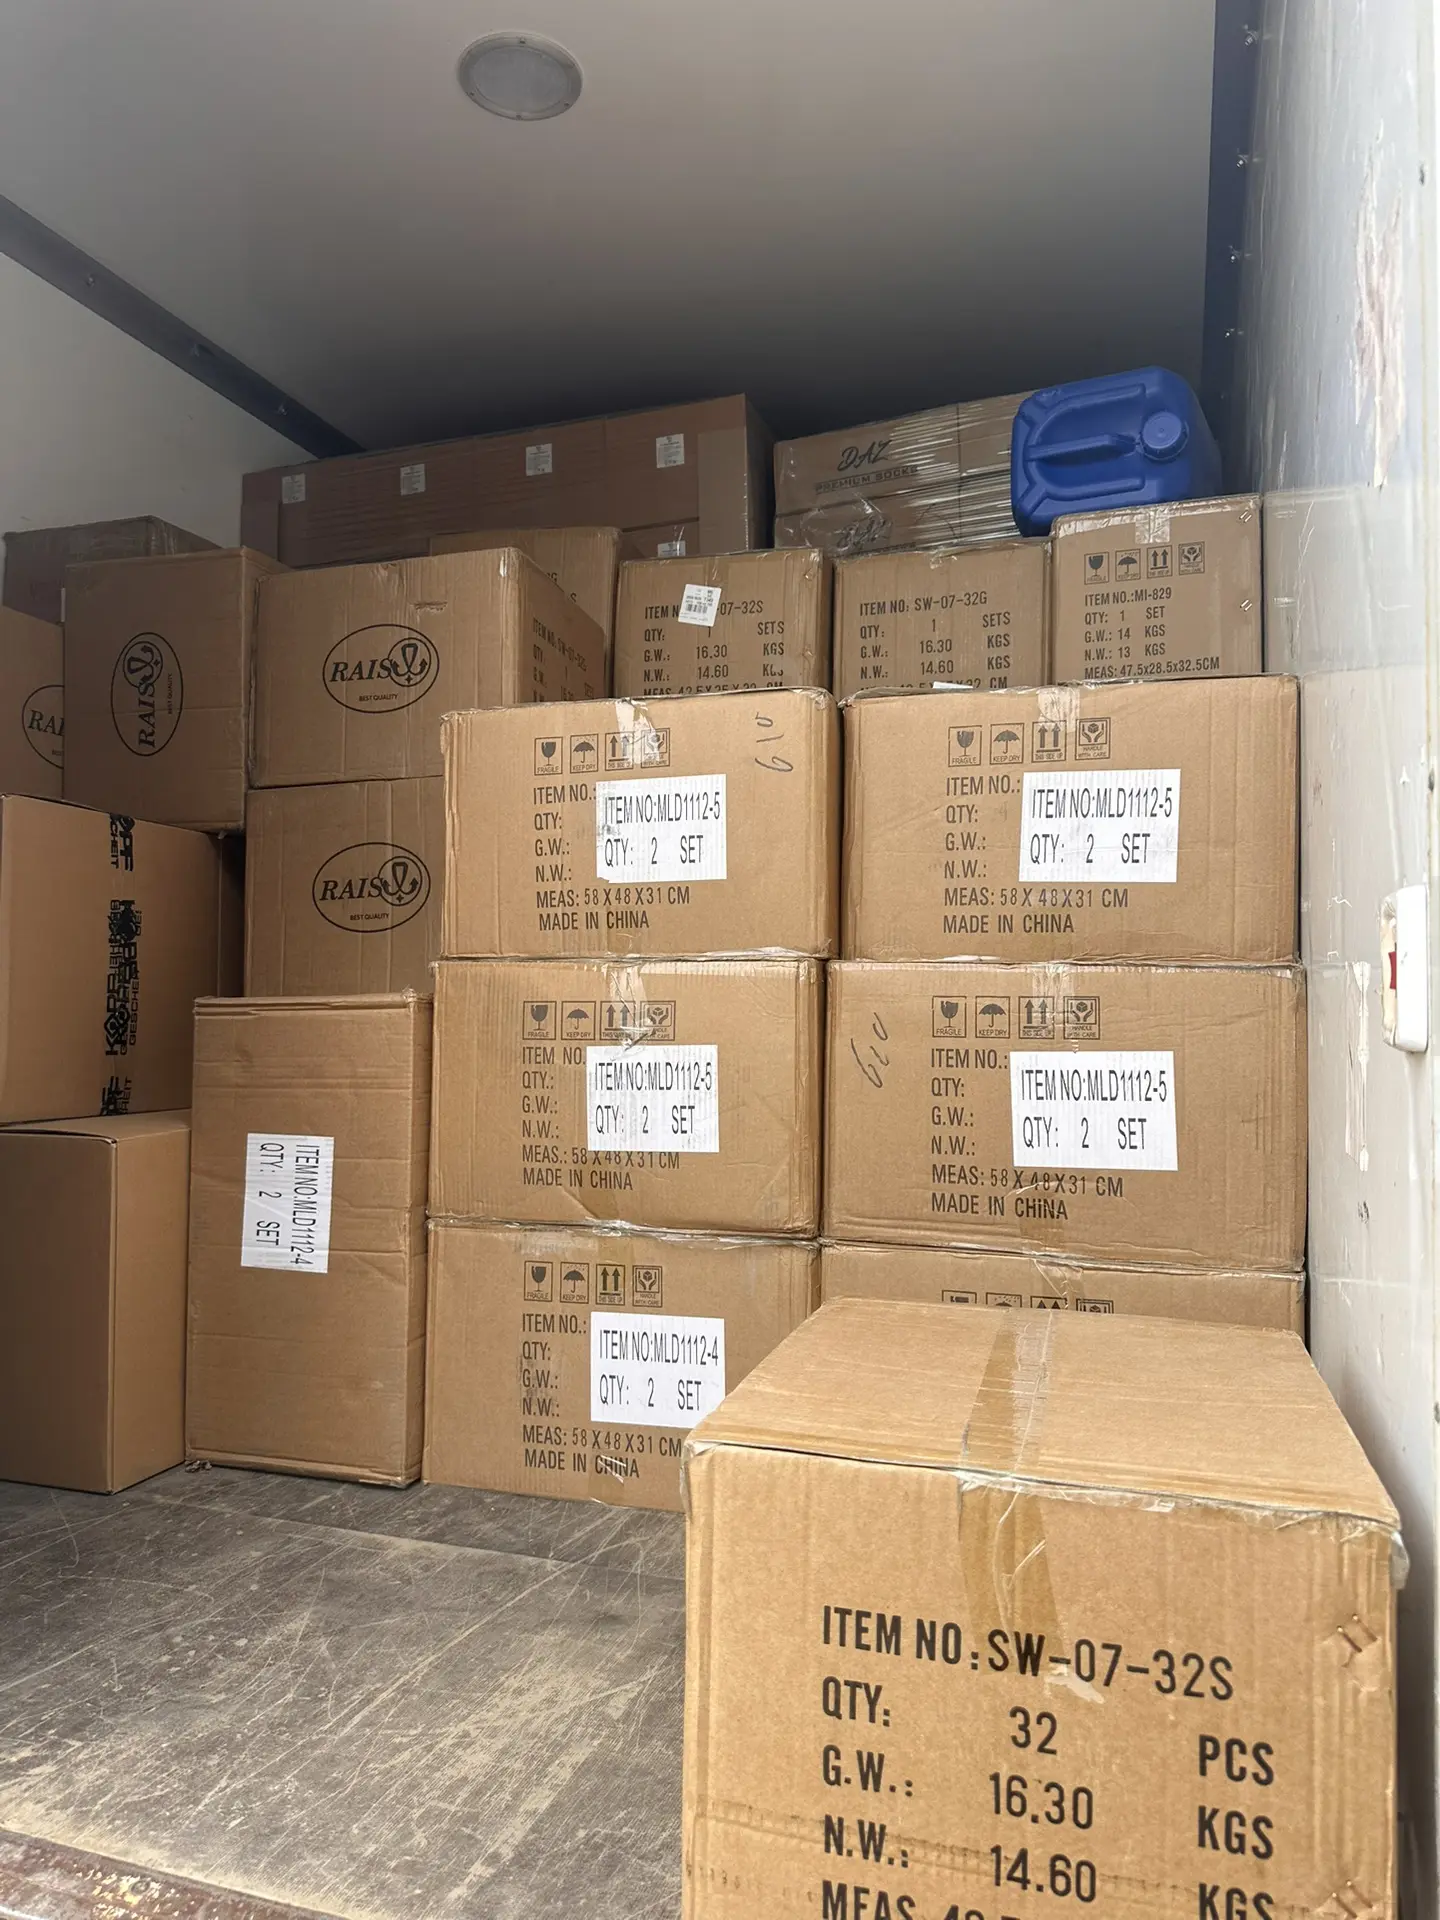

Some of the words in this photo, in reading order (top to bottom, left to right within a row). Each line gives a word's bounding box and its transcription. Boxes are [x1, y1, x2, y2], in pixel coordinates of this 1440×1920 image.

[837, 440, 892, 472] DAZ
[816, 475, 871, 492] PREMIUM
[860, 602, 886, 616] ITEM
[890, 600, 909, 613] NO:
[915, 591, 987, 611] SW-07-32G
[1085, 593, 1110, 606] ITEM
[645, 606, 669, 619] ITEM
[1085, 612, 1108, 625] QTY:
[1120, 610, 1125, 621] 1
[1146, 606, 1165, 619] SET
[644, 628, 665, 641] QTY:
[758, 621, 785, 635] SETS
[860, 625, 884, 638] QTY:
[982, 612, 1010, 628] SETS
[1085, 629, 1112, 643] G.W.:
[1118, 628, 1130, 640] 14
[1145, 625, 1165, 638] KGS
[644, 649, 670, 662] G.W.:
[697, 644, 728, 659] 16.30
[763, 642, 784, 656] KGS
[861, 645, 888, 658] G.W.:
[920, 639, 952, 653] 16.30
[987, 634, 1010, 648] KGS
[1085, 648, 1112, 661] N.W.:
[1118, 646, 1130, 659] 13
[1145, 643, 1165, 656] KGS
[644, 669, 670, 682] N.W.:
[698, 665, 728, 679] 14.60
[860, 666, 888, 679] N.W.:
[921, 660, 954, 675] 14.60
[987, 656, 1010, 670] KGS
[1085, 666, 1117, 679] MEAS:
[374, 693, 398, 701] QUALITY
[534, 786, 565, 804] ITEM
[946, 776, 983, 796] ITEM
[605, 796, 632, 824] ITEM
[1032, 789, 1066, 818] ITEM
[534, 813, 562, 830] QTY:
[946, 805, 978, 823] QTY:
[535, 839, 570, 856] G.W.:
[605, 838, 633, 867] QTY:
[651, 837, 658, 864] 2
[680, 835, 703, 864] SET
[946, 832, 986, 851] G.W.:
[1030, 834, 1064, 864] QTY:
[1086, 834, 1094, 863] 2
[1121, 833, 1150, 863] SET
[535, 865, 572, 882] N.W.:
[944, 860, 986, 879] N.W.:
[536, 890, 579, 908] MEAS:
[668, 886, 690, 904] CM
[944, 888, 994, 906] MEAS:
[1102, 889, 1128, 907] CM
[539, 912, 578, 931] MADE
[586, 912, 599, 930] IN
[607, 910, 649, 929] CHINA
[943, 915, 989, 933] MADE
[998, 915, 1013, 933] IN
[1023, 914, 1074, 933] CHINA
[522, 1047, 554, 1064] ITEM
[931, 1049, 969, 1069] ITEM
[522, 1071, 554, 1089] QTY.:
[595, 1062, 623, 1091] ITEM
[1021, 1070, 1056, 1101] ITEM
[931, 1078, 964, 1097] QTY:
[522, 1096, 557, 1114] G.W.:
[596, 1106, 623, 1134] QTY:
[642, 1106, 648, 1133] 2
[672, 1106, 695, 1134] SET
[931, 1106, 973, 1127] G.W.:
[522, 1120, 559, 1138] N.W.:
[1023, 1117, 1059, 1149] QTY:
[1082, 1118, 1089, 1148] 2
[1118, 1118, 1147, 1149] SET
[931, 1136, 976, 1156] N.W.:
[260, 1143, 284, 1172] QTY:
[522, 1145, 567, 1164] MEAS.:
[659, 1152, 680, 1169] CM
[523, 1168, 562, 1186] MADE
[569, 1169, 582, 1187] IN
[591, 1170, 633, 1190] CHINA
[932, 1164, 983, 1186] MEAS:
[1096, 1176, 1123, 1198] CM
[931, 1193, 978, 1214] MADE
[989, 1196, 1004, 1216] IN
[1015, 1198, 1068, 1220] CHINA
[256, 1221, 280, 1245] SET
[522, 1313, 554, 1333] ITEM
[523, 1341, 550, 1360] QTY:
[600, 1330, 628, 1360] ITEM
[523, 1369, 558, 1389] G.W.:
[600, 1374, 629, 1405] QTY:
[648, 1378, 654, 1407] 2
[678, 1380, 701, 1410] SET
[523, 1398, 559, 1417] N.W.:
[523, 1425, 566, 1446] MEAS:
[659, 1438, 681, 1457] CM
[525, 1449, 565, 1471] MADE
[573, 1453, 586, 1472] IN
[595, 1455, 639, 1478] CHINA
[823, 1605, 900, 1655] ITEM
[822, 1676, 890, 1727] QTY:
[1009, 1706, 1057, 1755] 32
[1199, 1734, 1274, 1786] PCS
[822, 1744, 913, 1796] G.W.:
[990, 1772, 1094, 1829] 16.30
[1198, 1805, 1274, 1860] KGS
[824, 1814, 908, 1867] N.W.:
[990, 1845, 1096, 1903] 14.60
[1199, 1882, 1274, 1920] KGS
